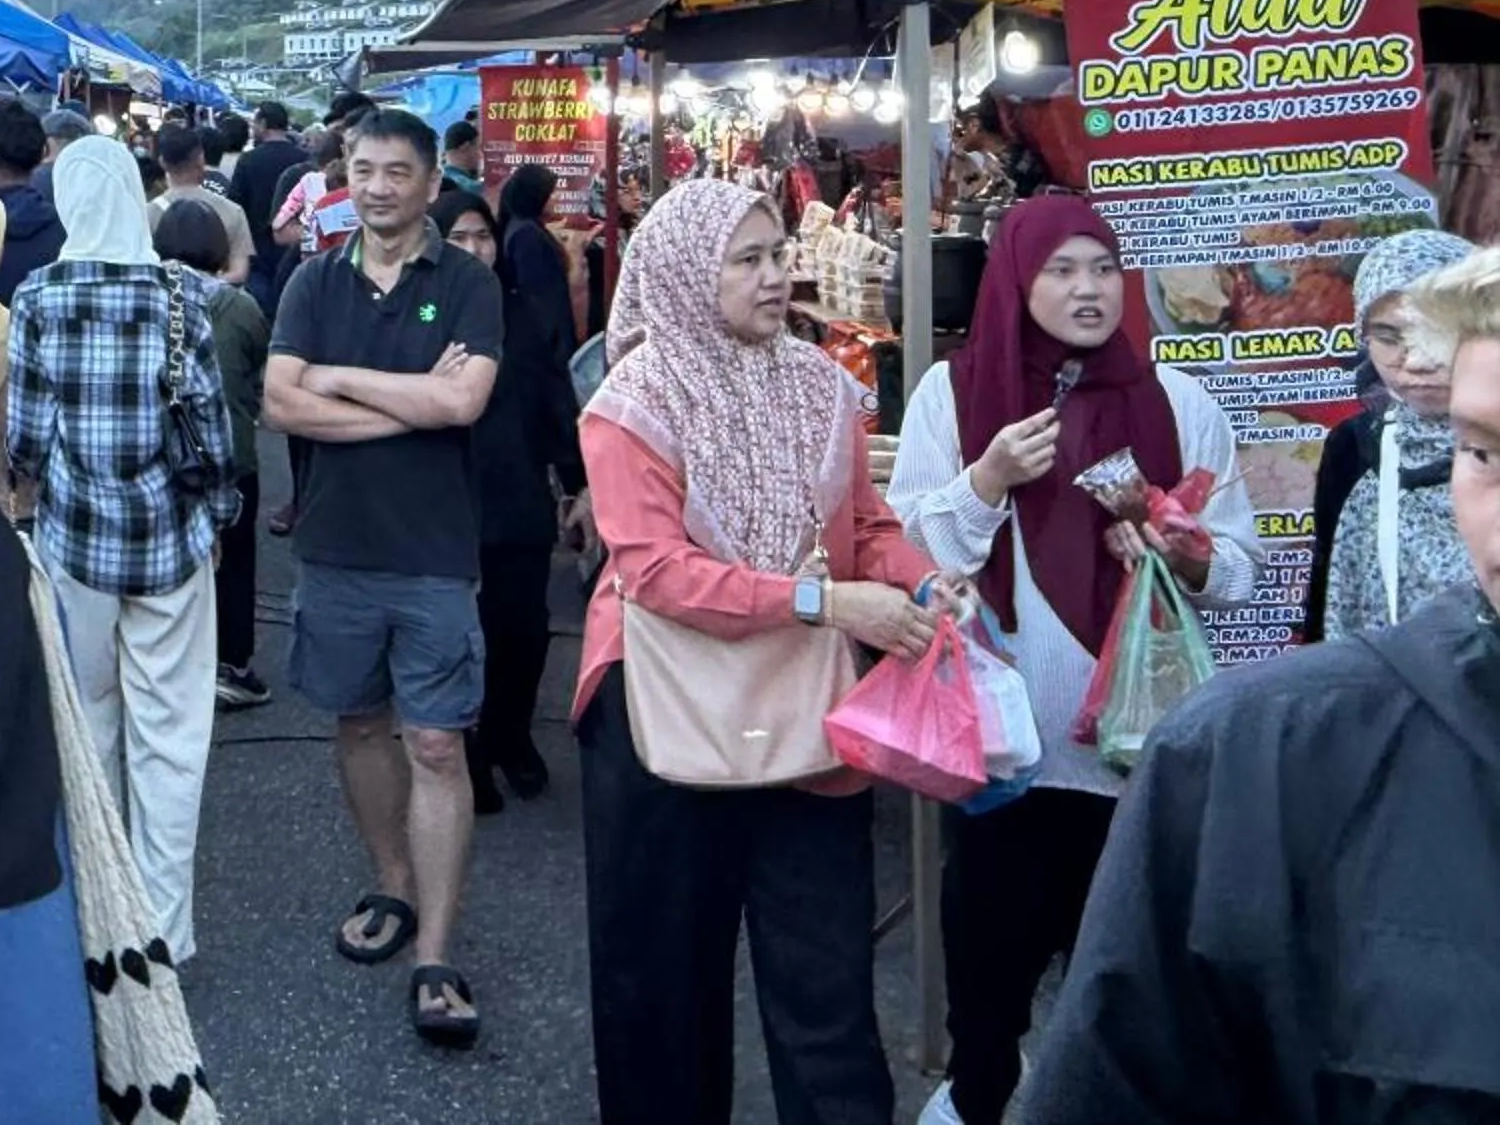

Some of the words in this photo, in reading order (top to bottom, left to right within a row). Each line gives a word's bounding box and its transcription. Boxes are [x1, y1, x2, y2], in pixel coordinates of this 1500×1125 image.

[1084, 54, 1244, 102] DAPUR
[1254, 38, 1410, 88] PANAS
[511, 78, 578, 98] KUNAFA
[515, 124, 577, 142] COKLAT
[1092, 161, 1154, 187] NASI
[1156, 153, 1262, 183] KERABU
[1264, 145, 1346, 175] TUMIS
[1349, 140, 1403, 169] ADP
[1128, 198, 1185, 213] KERABU
[1189, 194, 1235, 208] TUMIS
[1301, 187, 1324, 200] 1/2
[1337, 185, 1359, 197] RM
[1130, 216, 1187, 231] KERABU
[1191, 212, 1237, 227] TUMIS
[1240, 209, 1281, 224] AYAM
[1285, 203, 1358, 220] BEREMPAH
[1372, 200, 1395, 212] RM
[1399, 198, 1431, 211] 9.00
[1131, 234, 1189, 249] KERABU
[1193, 229, 1239, 245] TUMIS
[1139, 251, 1218, 266] BEREMPAH
[1317, 242, 1339, 254] RM
[1156, 336, 1224, 363] NASI
[1231, 330, 1327, 360] LEMAK
[1331, 327, 1357, 353] A
[1207, 375, 1253, 388] TUMIS
[1212, 393, 1255, 406] UMIS
[1257, 389, 1299, 404] AYAM
[1303, 387, 1357, 401] BEREMP
[1228, 411, 1257, 424] MIS
[1299, 427, 1324, 438] 1/2
[1254, 512, 1315, 537] ERLA
[1216, 609, 1256, 623] KELI
[1261, 608, 1304, 621] BERL
[1220, 627, 1290, 643] RM2.00
